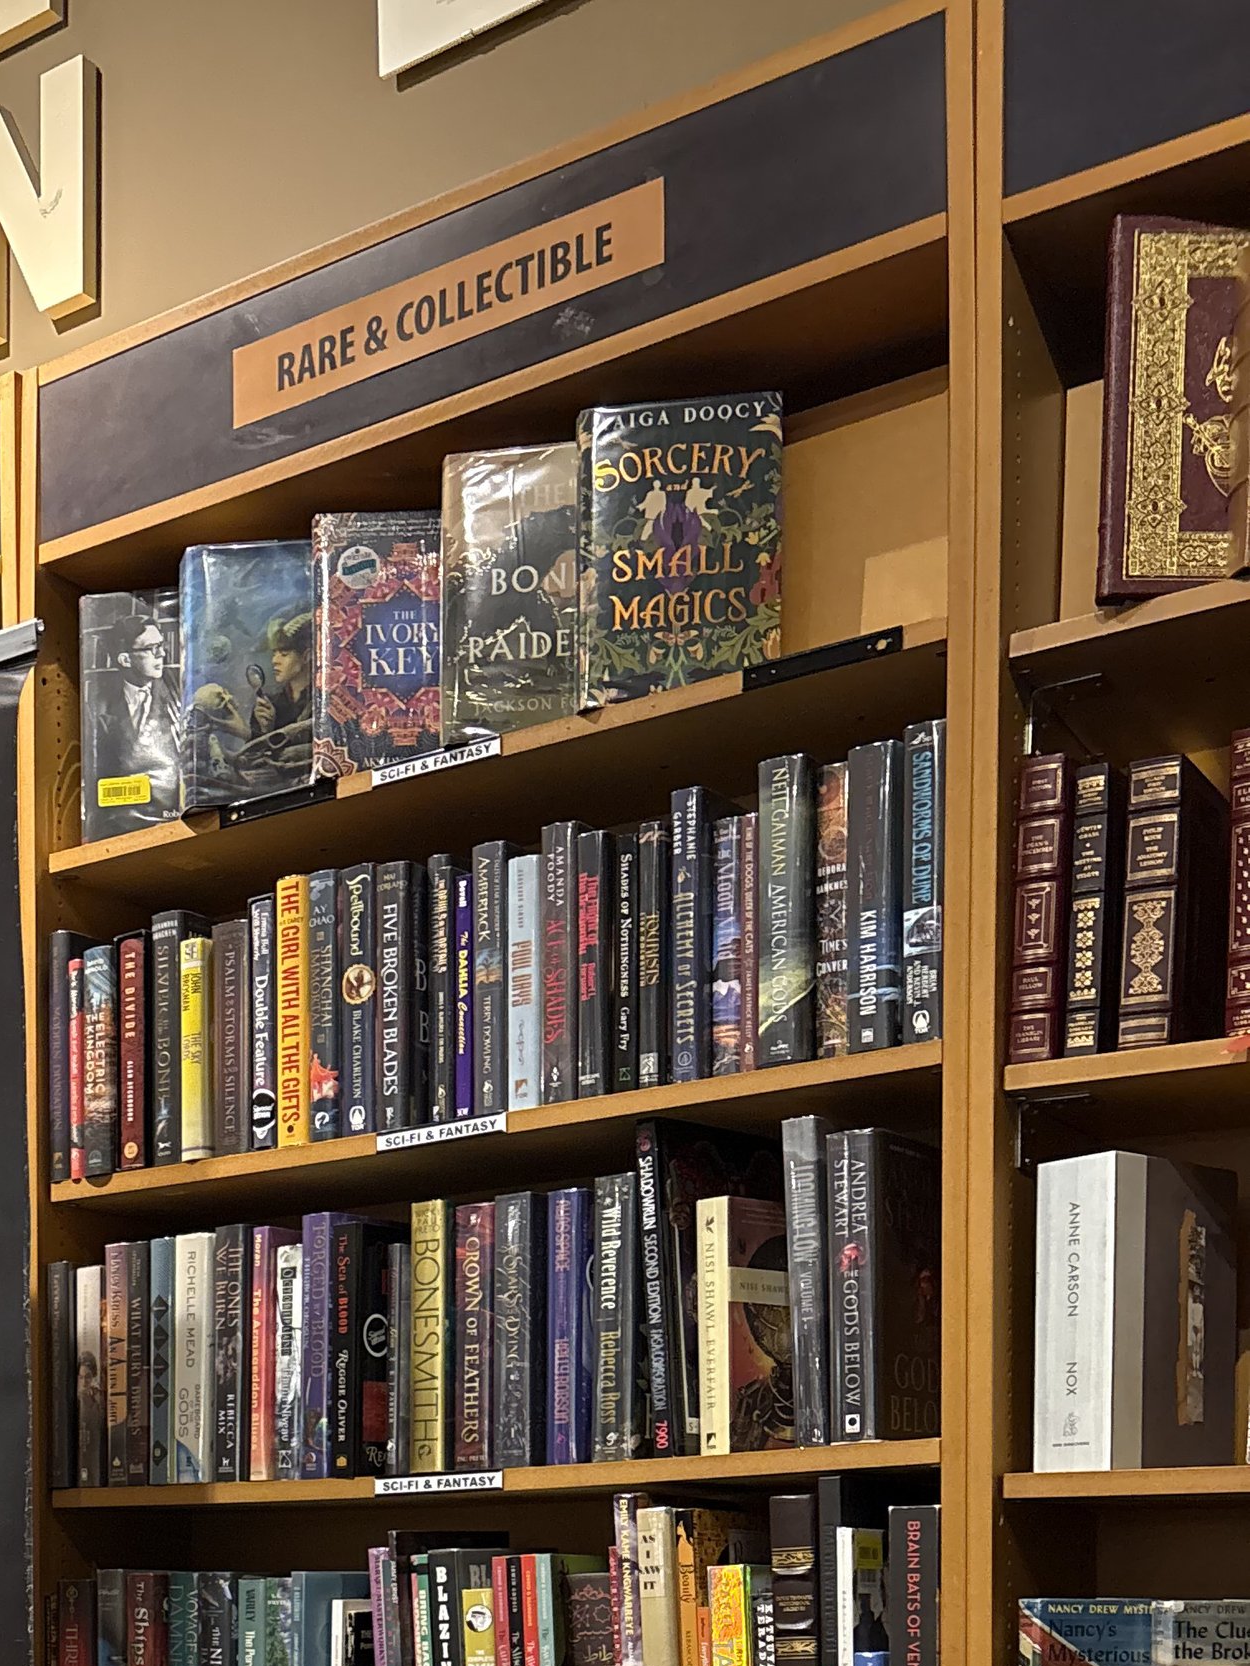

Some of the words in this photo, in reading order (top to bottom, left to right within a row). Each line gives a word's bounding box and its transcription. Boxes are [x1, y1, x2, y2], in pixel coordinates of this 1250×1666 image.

[277, 326, 354, 392] RARE
[364, 316, 388, 356] &
[396, 222, 613, 341] COLLECTIBLE
[594, 444, 766, 491] SORCERY
[666, 482, 688, 492] and
[612, 544, 743, 582] SMALL
[610, 588, 747, 632] MAGICS
[380, 762, 417, 782] SCI-FI
[419, 757, 430, 771] &
[433, 743, 492, 768] FANTASY
[771, 768, 789, 806] NEIL
[771, 809, 787, 876] GAIMAN
[281, 881, 299, 917] THE
[383, 903, 397, 941] FIVE
[770, 884, 788, 971] AMERICAN
[860, 910, 877, 938] KIM
[281, 926, 299, 964] GIRL
[125, 952, 135, 979] THE
[381, 949, 398, 1022] BROKEN
[859, 943, 877, 1016] HARRISON
[255, 974, 268, 1029] Double
[282, 965, 299, 1009] WITH
[771, 975, 788, 1023] GODS
[125, 987, 135, 1038] DIVIDE
[282, 1015, 299, 1043] ALL
[255, 1032, 268, 1085] Feature
[282, 1042, 299, 1075] THE
[383, 1029, 398, 1096] BLADES
[282, 1078, 299, 1123] GIFTS
[385, 1131, 422, 1148] SCI-FI
[426, 1129, 435, 1140] &
[438, 1118, 498, 1141] FANTASY
[600, 1204, 622, 1236] Wild
[1068, 1202, 1081, 1247] ANNE
[186, 1251, 196, 1322] RICHELLE
[462, 1236, 482, 1312] CROWN
[600, 1240, 622, 1310] Reverence
[1067, 1252, 1080, 1317] CARSON
[465, 1317, 478, 1336] OF
[843, 1279, 859, 1336] GODS
[186, 1328, 195, 1368] MEAD
[413, 1239, 440, 1442] BONESMITH
[600, 1329, 621, 1388] Rebecca
[462, 1344, 480, 1443] FEATHERS
[844, 1342, 861, 1406] BELOW
[1066, 1361, 1078, 1397] NOX
[178, 1388, 188, 1438] GODS
[218, 1410, 226, 1435] MIX
[600, 1392, 620, 1424] Ross
[382, 1477, 420, 1492] SCI-FI
[423, 1476, 433, 1488] &
[436, 1475, 496, 1490] FANTASY
[619, 1499, 631, 1529] EMILY
[620, 1530, 632, 1560] KAME
[906, 1520, 921, 1570] BRAIN
[622, 1562, 634, 1636] KNGWARREYE
[906, 1573, 921, 1611] BATS
[1048, 1604, 1083, 1614] NANCY
[1089, 1604, 1119, 1614] DREW
[906, 1615, 921, 1637] OF
[1049, 1620, 1117, 1640] Nancy's
[1173, 1620, 1208, 1639] The
[1048, 1644, 1150, 1665] Mysterious
[1174, 1641, 1204, 1660] the
